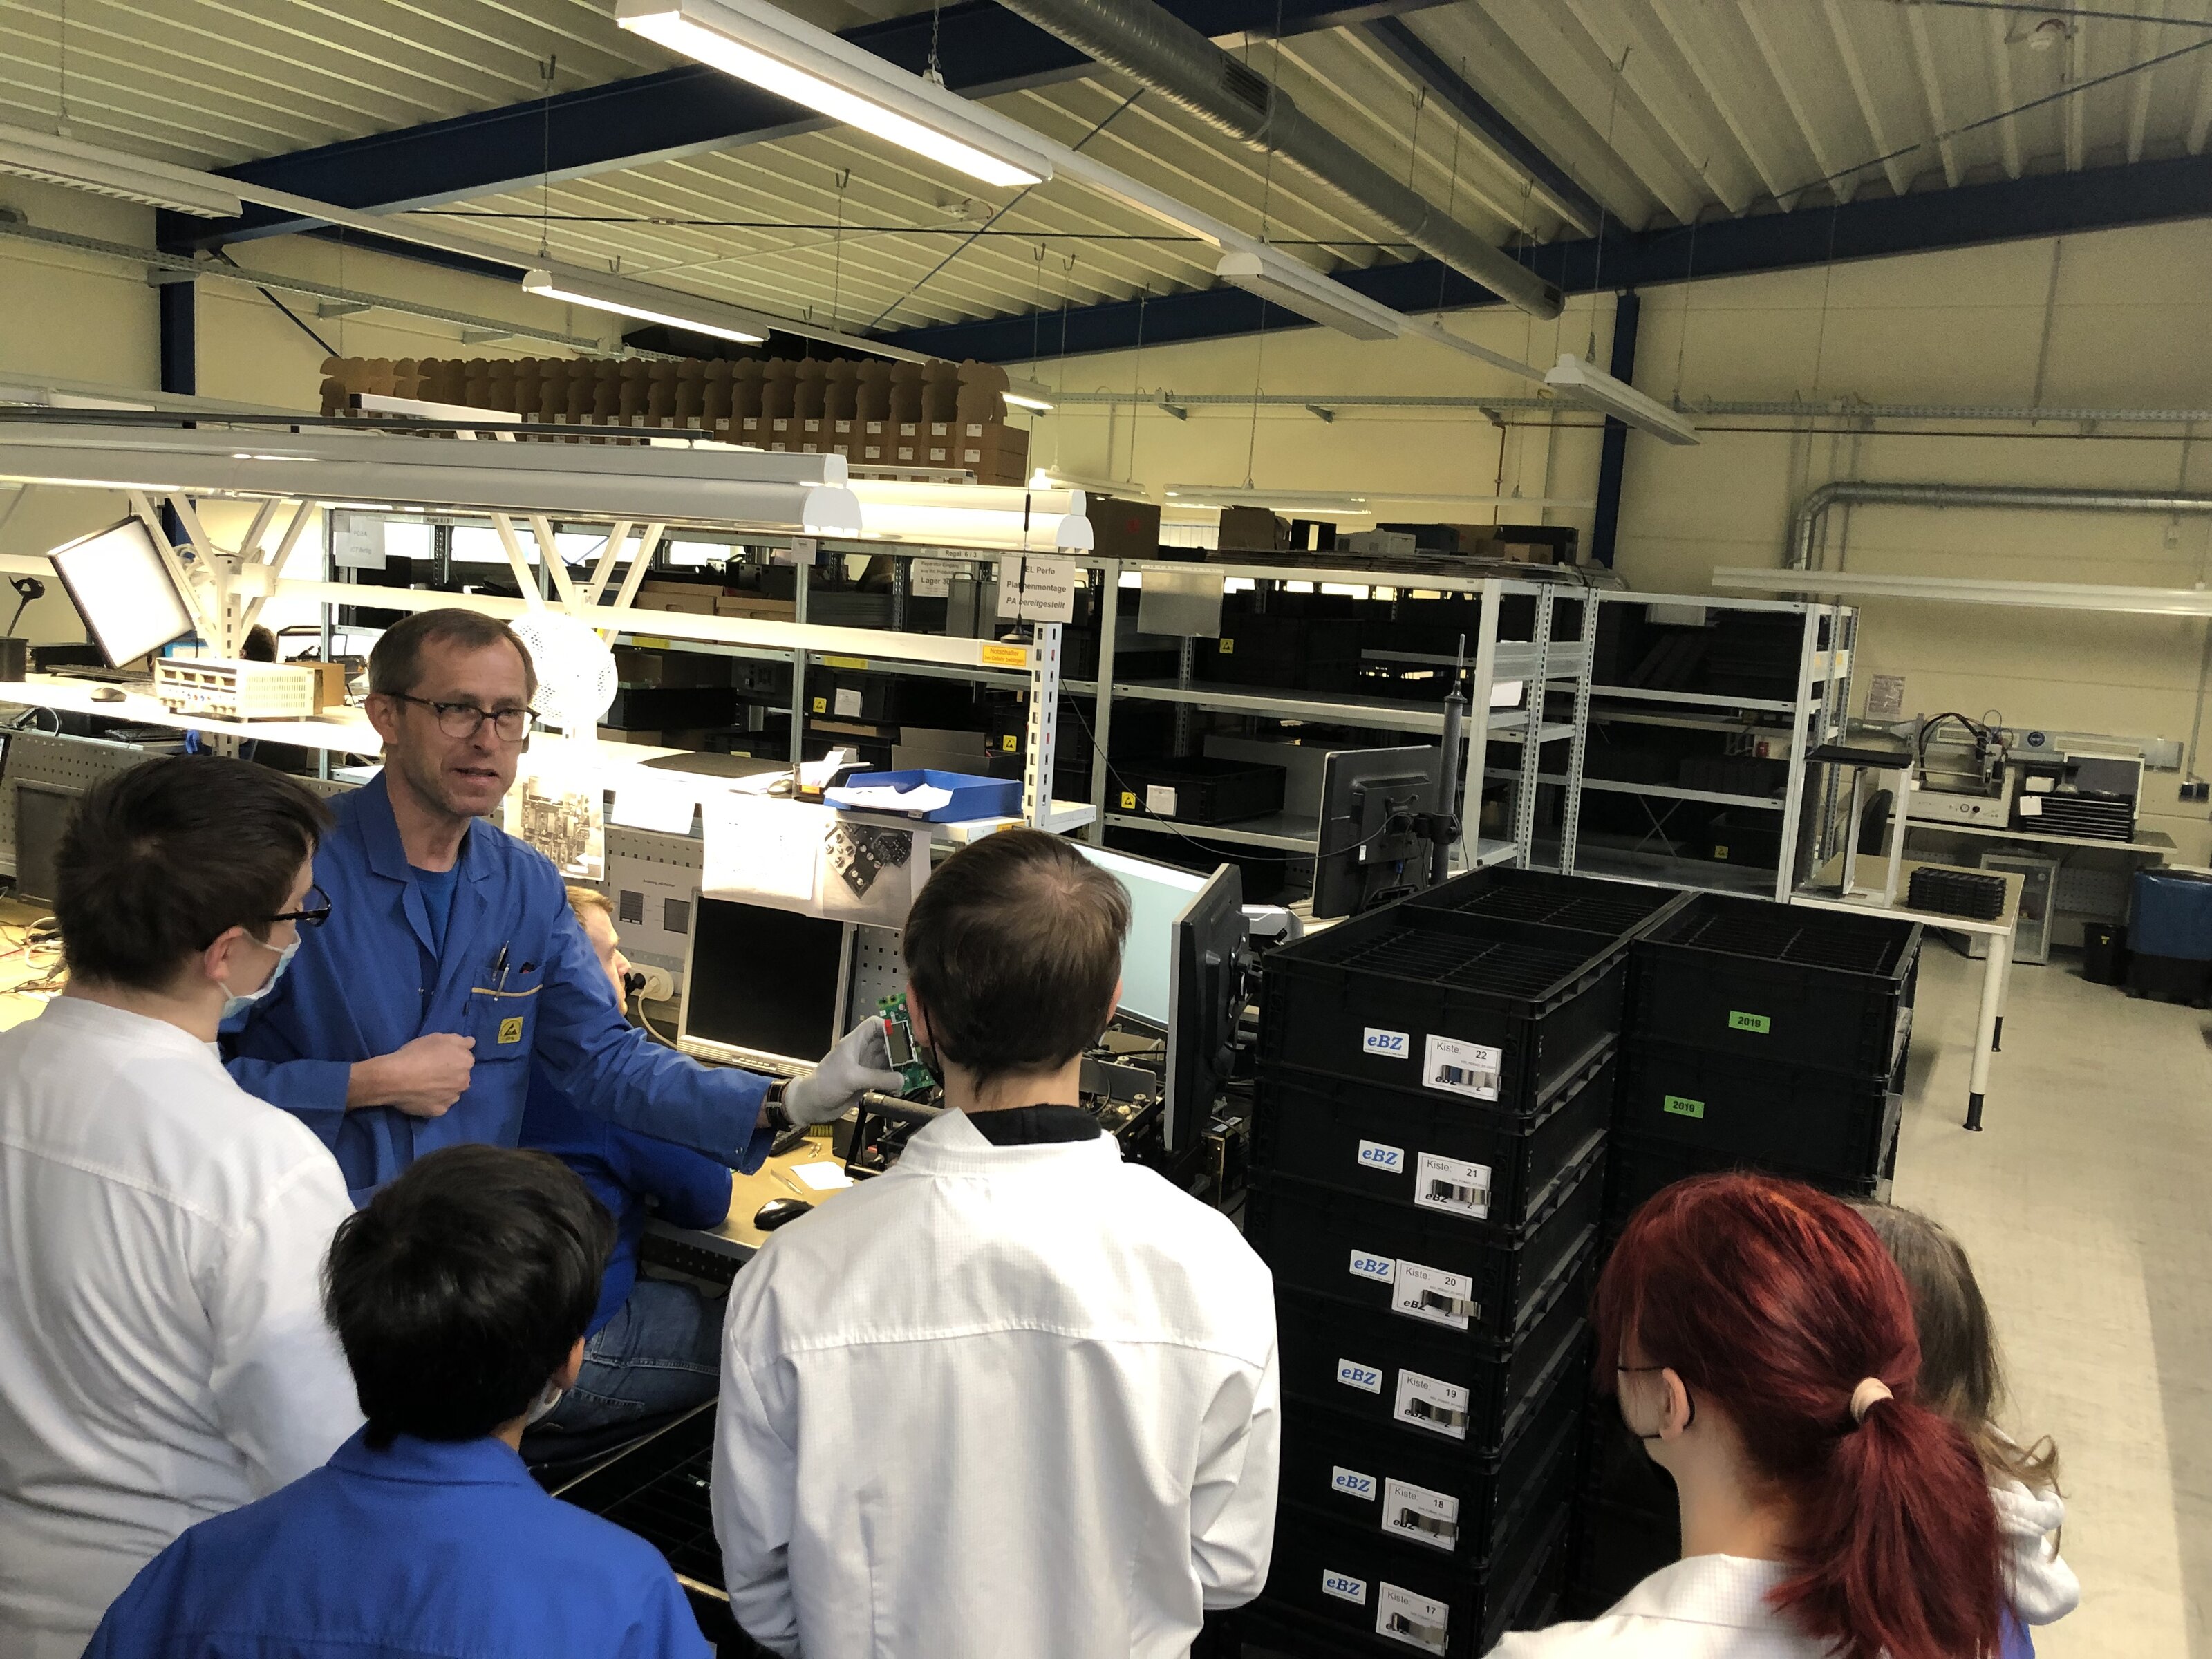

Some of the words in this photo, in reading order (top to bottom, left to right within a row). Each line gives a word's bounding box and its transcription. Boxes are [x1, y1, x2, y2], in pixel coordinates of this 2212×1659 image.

[945, 550, 962, 558] Regal
[1036, 566, 1056, 575] Perfo
[921, 576, 940, 586] Lager
[1006, 597, 1017, 605] PA
[1018, 599, 1066, 609] bereitgestellt
[990, 648, 1020, 656] Notschalter
[1738, 1016, 1761, 1028] 2019
[1367, 1034, 1403, 1050] eBZ
[1475, 1050, 1488, 1060] 22
[1672, 1100, 1695, 1112] 2019
[1362, 1148, 1398, 1165] eBZ
[1466, 1168, 1477, 1177] 21
[1354, 1259, 1390, 1276] eBZ
[1445, 1277, 1456, 1286] 20
[1342, 1367, 1376, 1385] eBZ
[1446, 1389, 1456, 1398] 19
[1336, 1475, 1371, 1493] eBZ
[1434, 1499, 1444, 1508] 18
[1327, 1578, 1360, 1595] eBZ
[1425, 1605, 1436, 1615] 17
